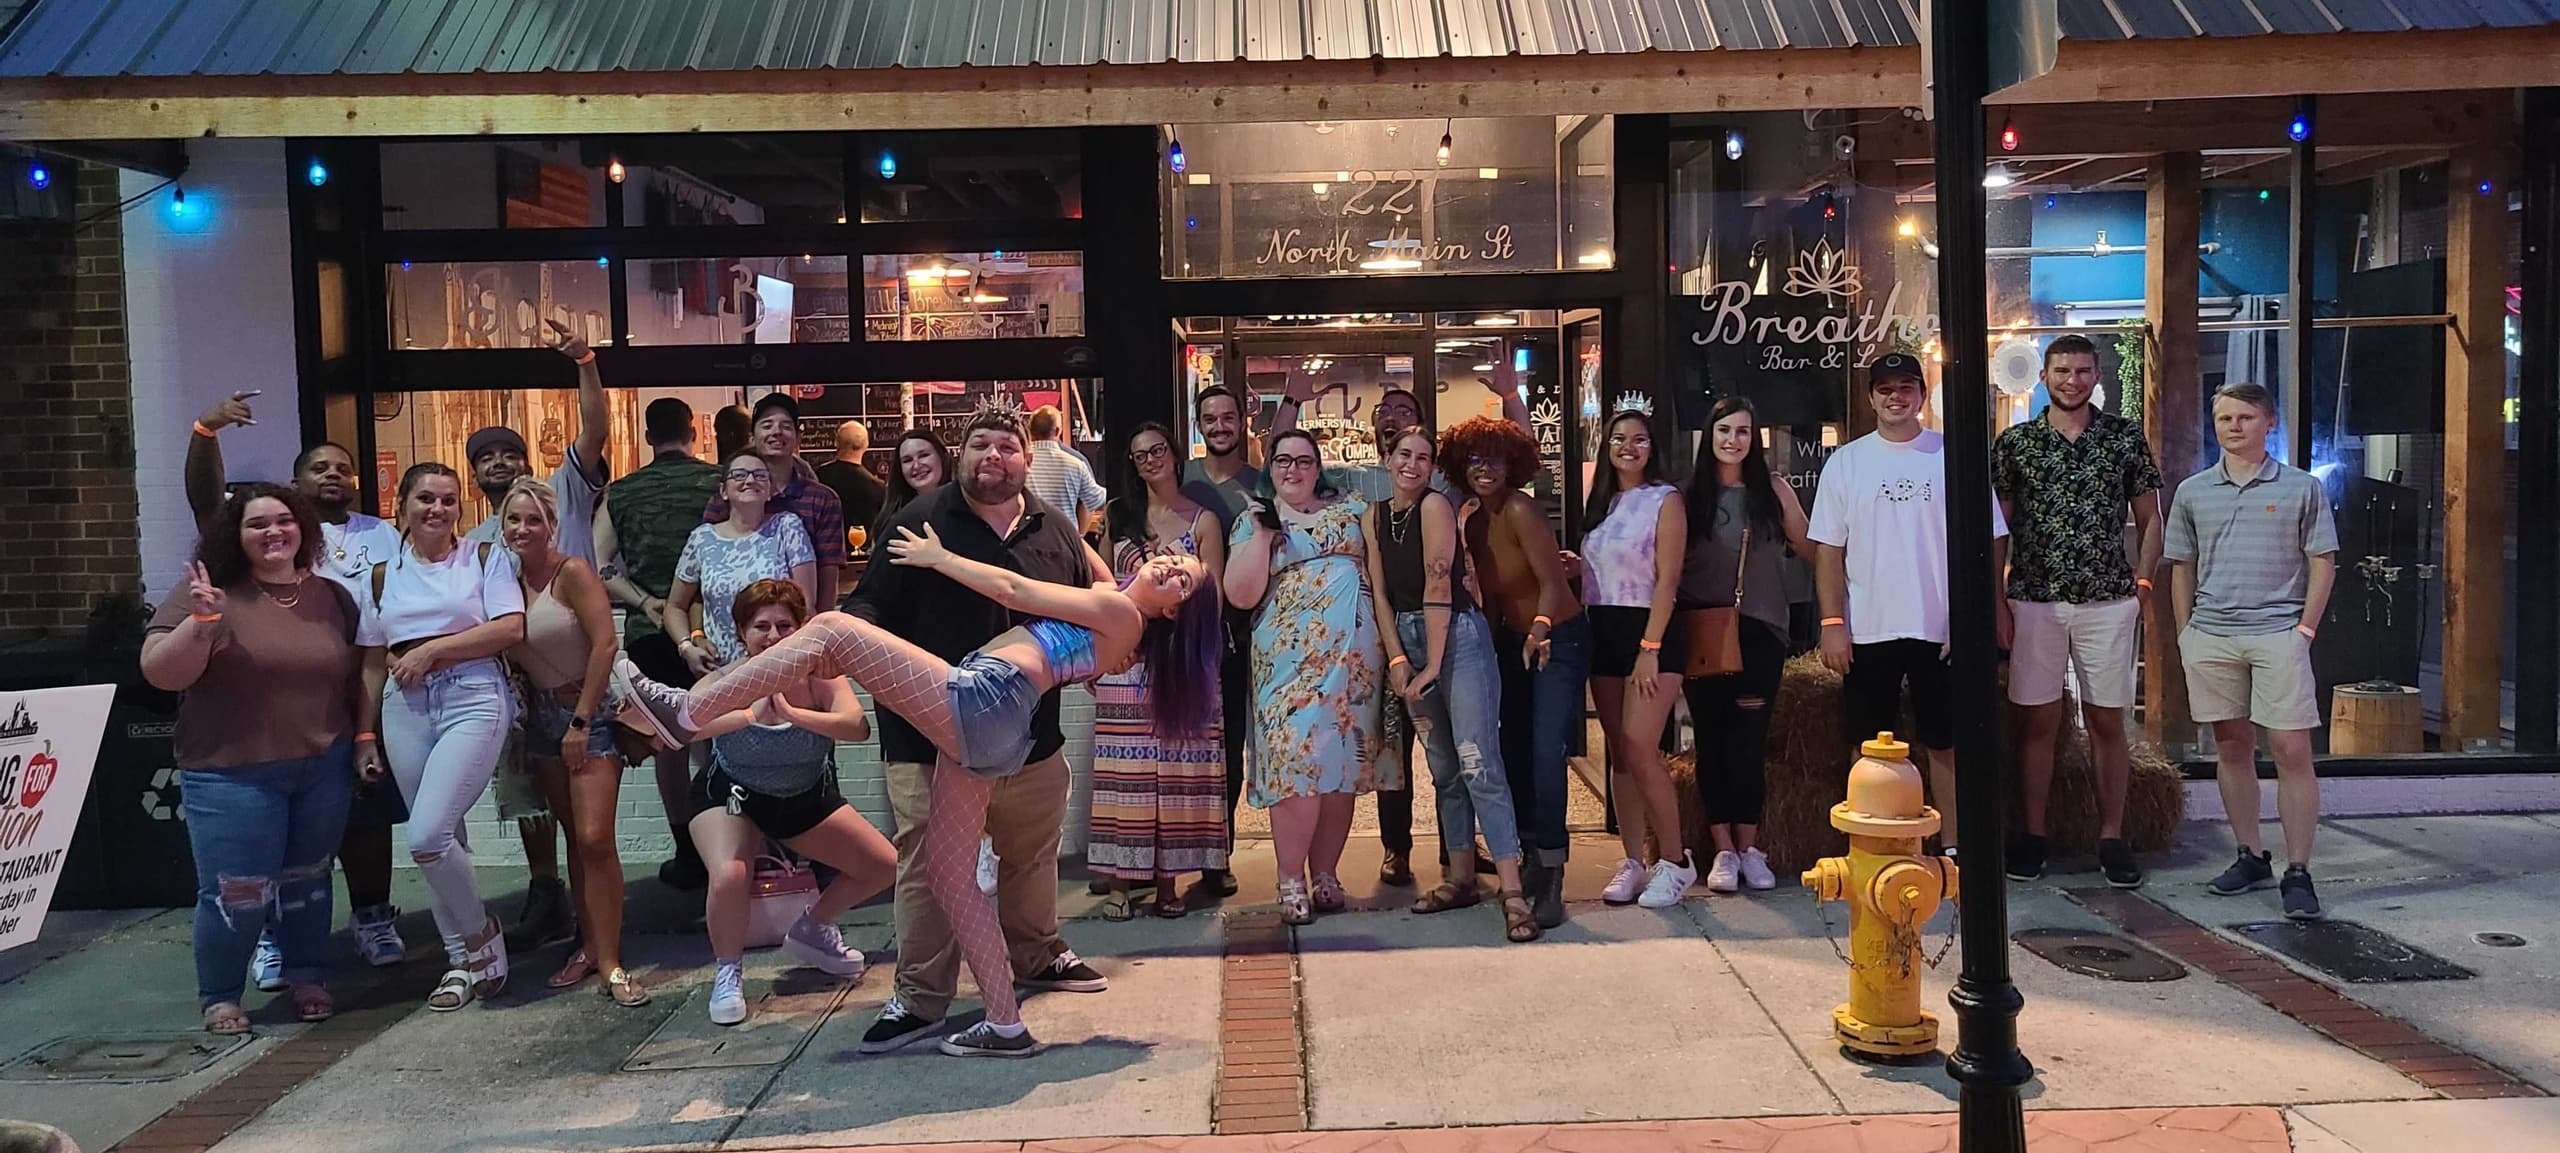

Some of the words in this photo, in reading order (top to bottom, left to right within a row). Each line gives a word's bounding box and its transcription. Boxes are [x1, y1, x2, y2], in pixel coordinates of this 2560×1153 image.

[1257, 228, 1359, 264] North
[1368, 226, 1472, 262] Main
[1481, 224, 1515, 260] St
[1692, 280, 1939, 345] Breathe
[1760, 345, 1812, 370] Bar
[1820, 344, 1844, 369] &
[1296, 418, 1367, 431] KERNERSVILLE
[1771, 470, 1818, 488] raft
[24, 763, 53, 794] FOR
[0, 848, 62, 885] TAURANT
[24, 883, 37, 904] in
